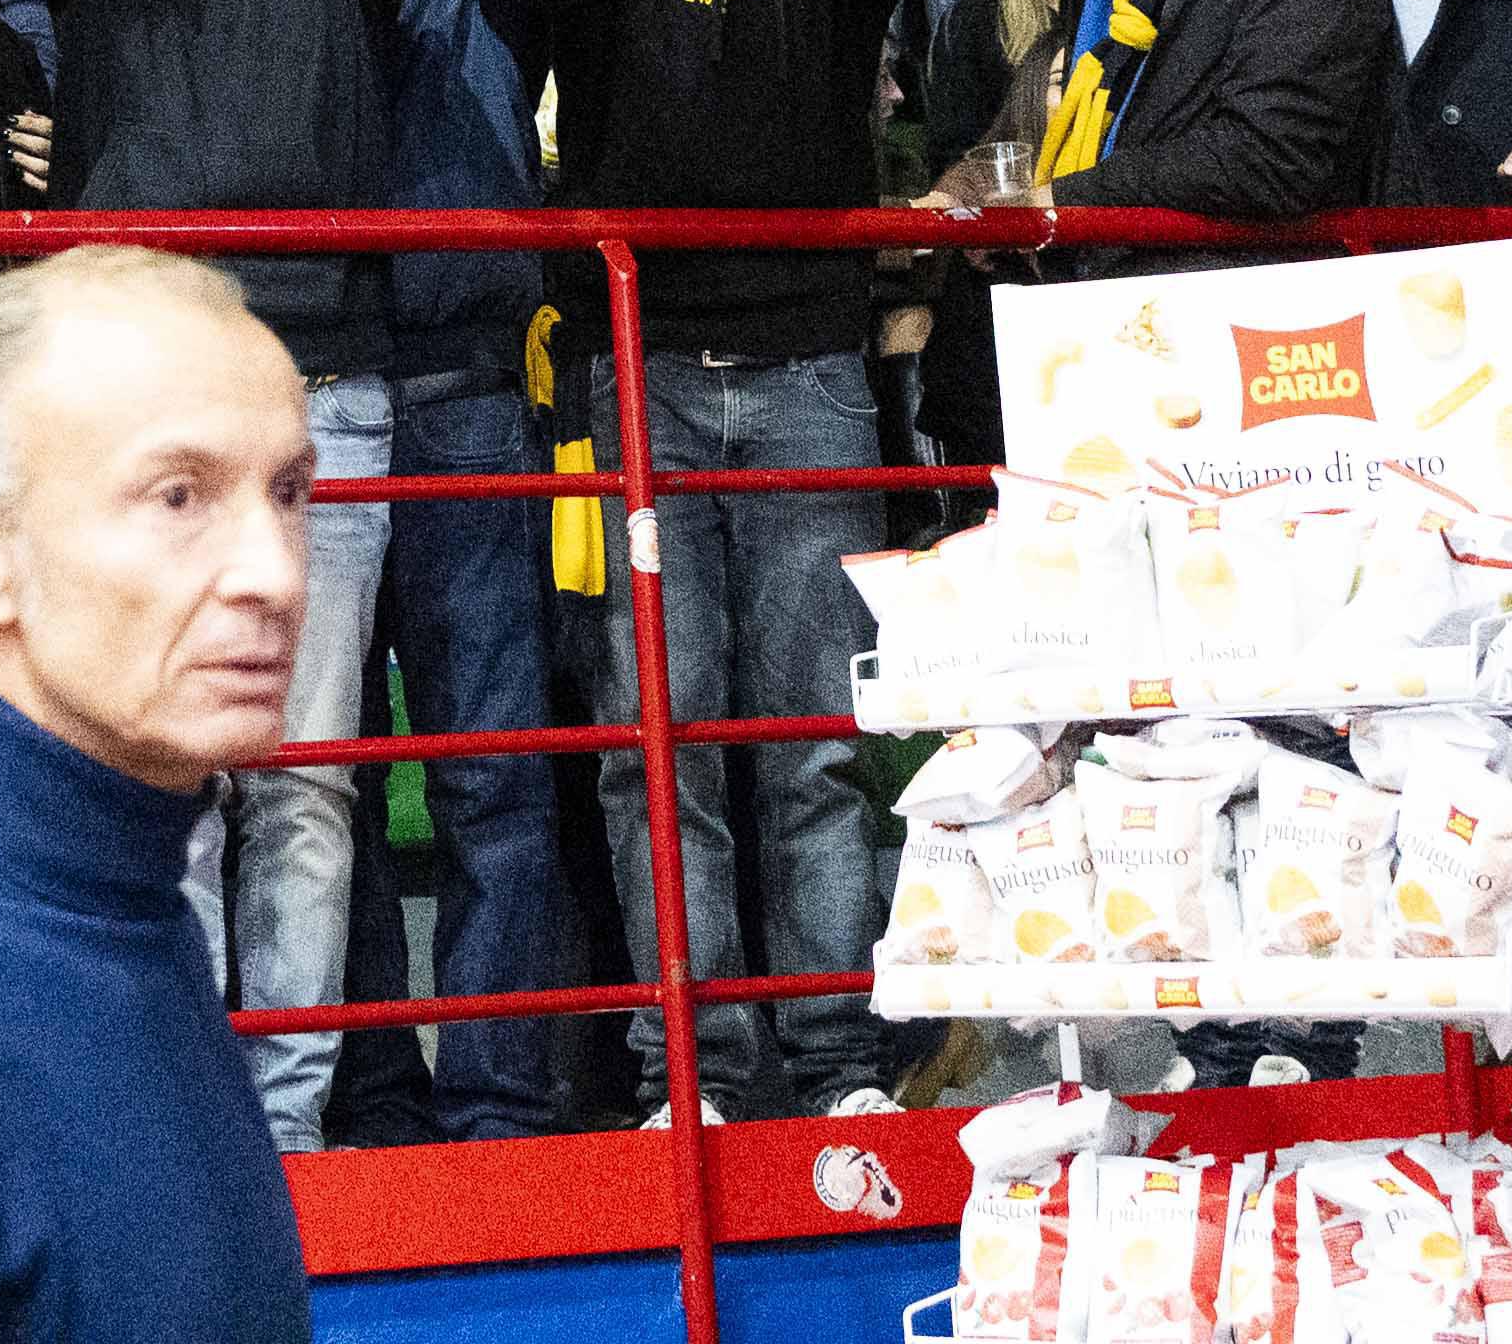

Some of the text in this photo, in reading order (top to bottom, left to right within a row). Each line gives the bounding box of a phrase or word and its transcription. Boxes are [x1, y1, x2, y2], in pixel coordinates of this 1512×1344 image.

[1265, 341, 1338, 374] SAN
[1249, 368, 1362, 406] CARLO
[1181, 450, 1446, 493] Viviamo di gsto
[1132, 692, 1171, 704] CARLO
[904, 834, 975, 868] piùgust
[992, 856, 1094, 898] piùgusto
[1157, 991, 1197, 1003] CARLO
